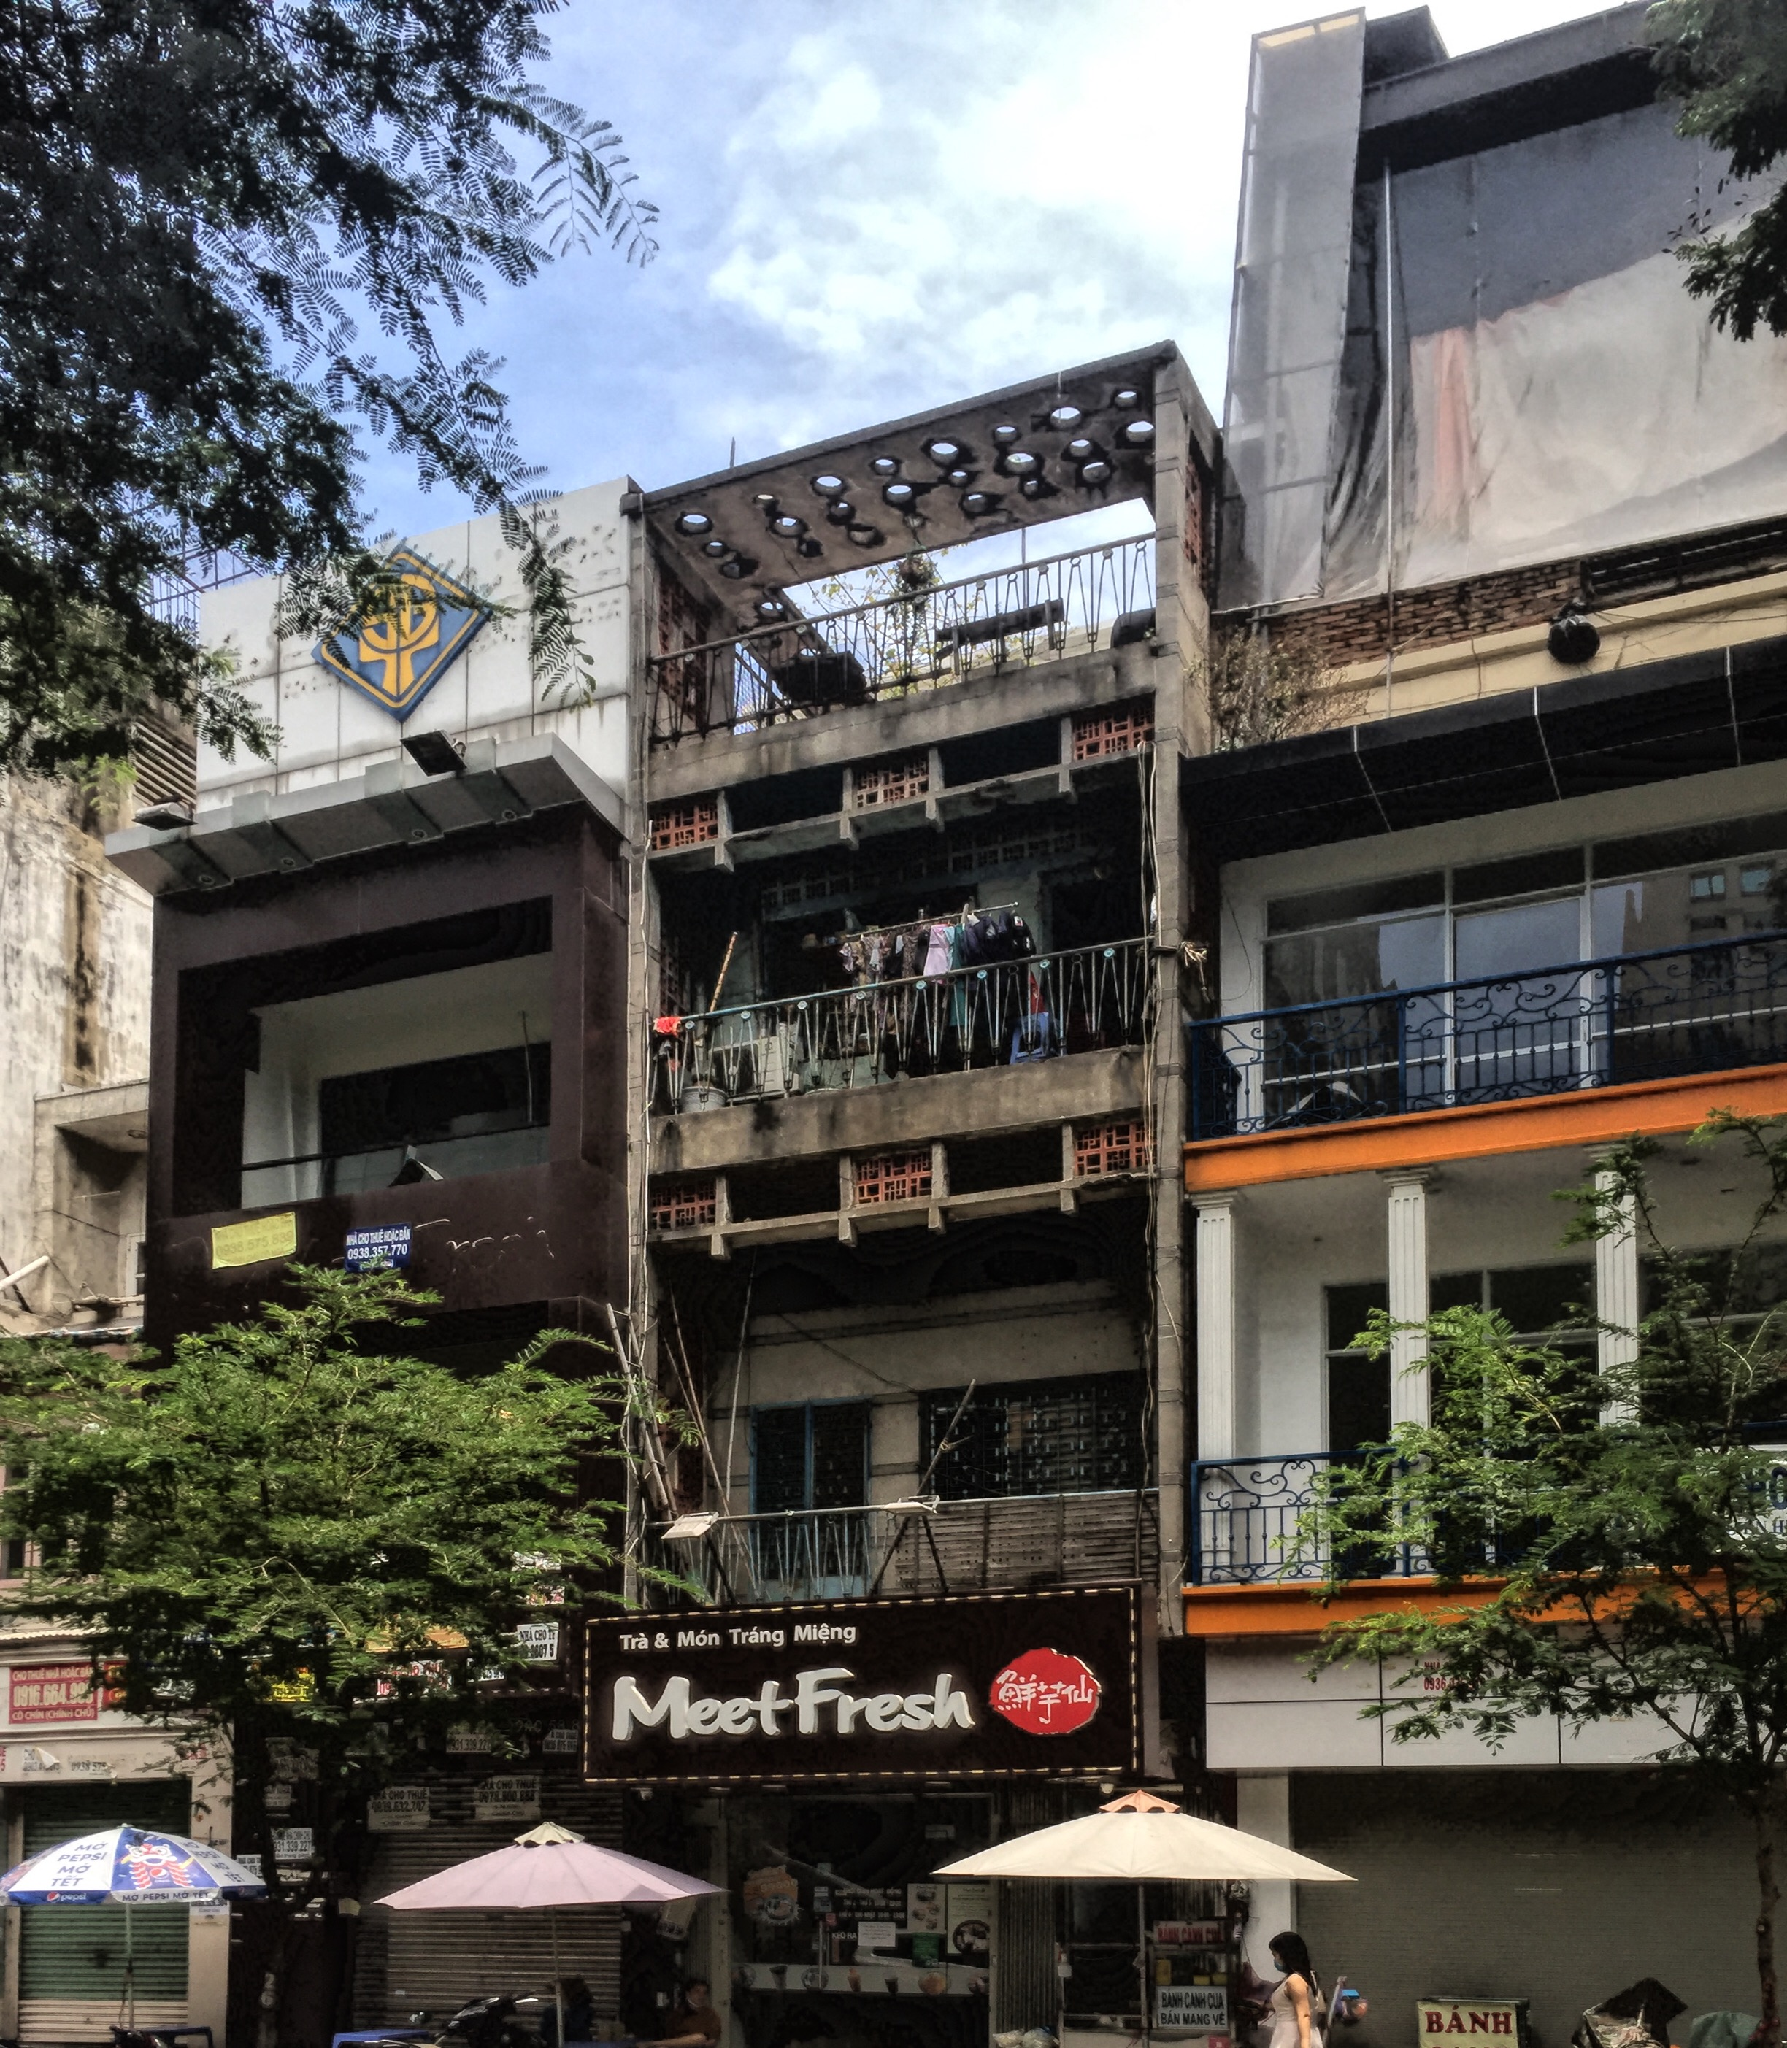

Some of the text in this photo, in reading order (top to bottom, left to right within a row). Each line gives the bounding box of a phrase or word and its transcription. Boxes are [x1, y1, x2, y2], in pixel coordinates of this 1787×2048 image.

[619, 1622, 857, 1650] Trà & Món Tráng Miệng
[996, 1670, 1094, 1724] 鮮芋仙
[57, 1852, 108, 1863] PEPSI
[51, 1875, 84, 1887] TẾT
[60, 1892, 87, 1902] pepsi
[143, 1892, 170, 1901] PEPSI
[1184, 1992, 1206, 2009] CANH
[1207, 1992, 1225, 2009] CUA
[1182, 2012, 1211, 2026] MANG
[1425, 2004, 1513, 2034] BÁNH
